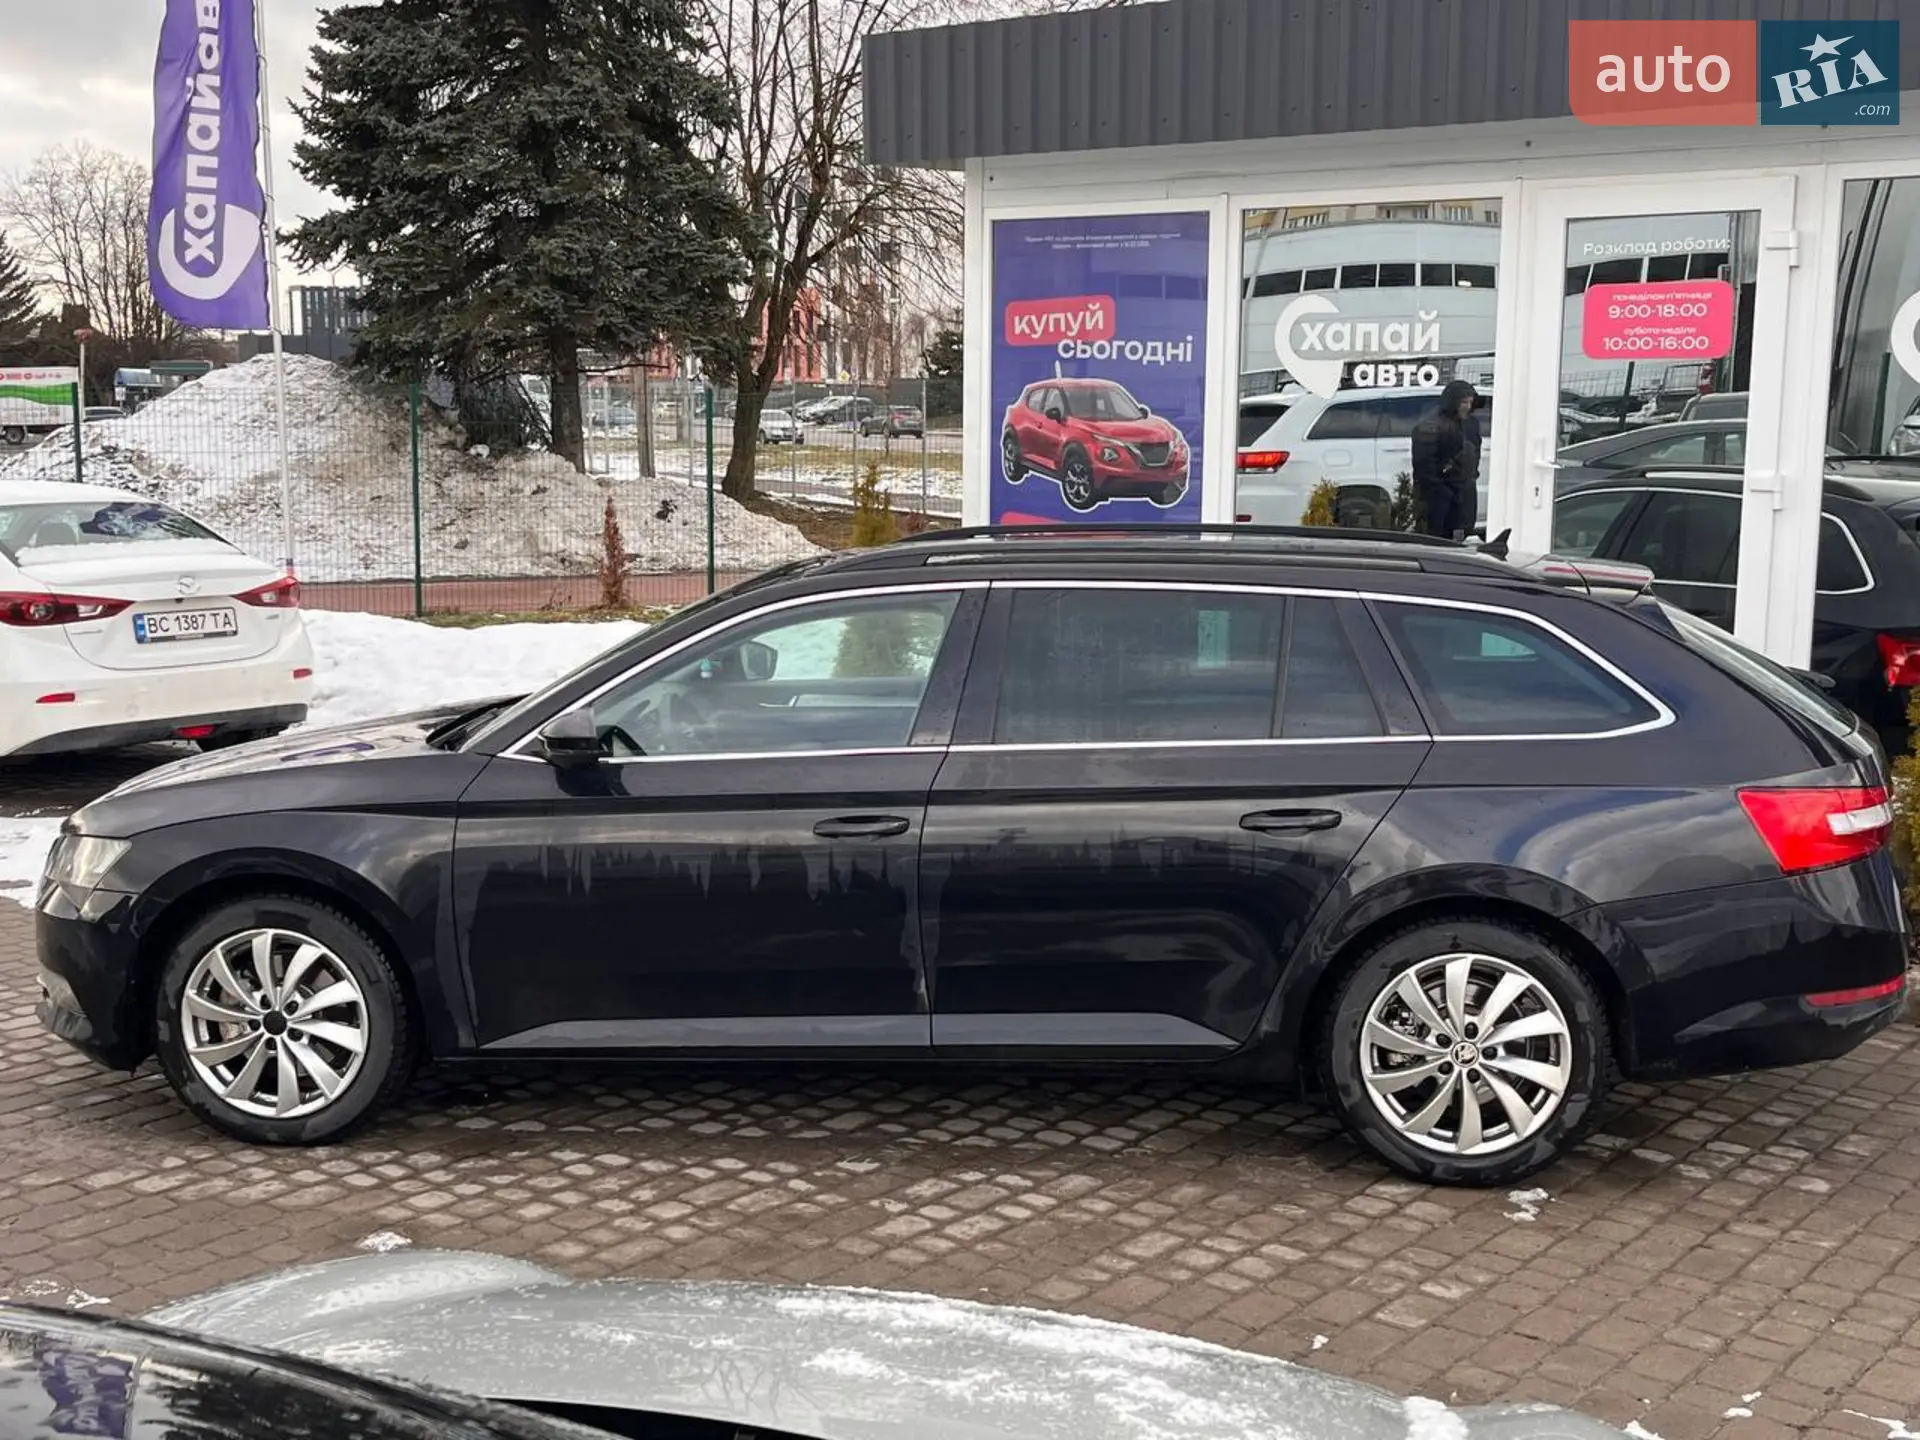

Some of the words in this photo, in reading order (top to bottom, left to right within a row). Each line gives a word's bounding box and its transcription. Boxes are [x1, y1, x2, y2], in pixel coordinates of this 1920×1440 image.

[1583, 241, 1657, 256] Розклад
[1013, 302, 1104, 339] купуй
[1608, 303, 1707, 319] 9:00-18:00
[1057, 335, 1193, 366] сьогодні
[1603, 336, 1709, 351] 10:00-16:00
[1353, 363, 1439, 387] авто
[148, 617, 170, 634] BC
[175, 614, 206, 631] 1387
[212, 612, 233, 627] TA
